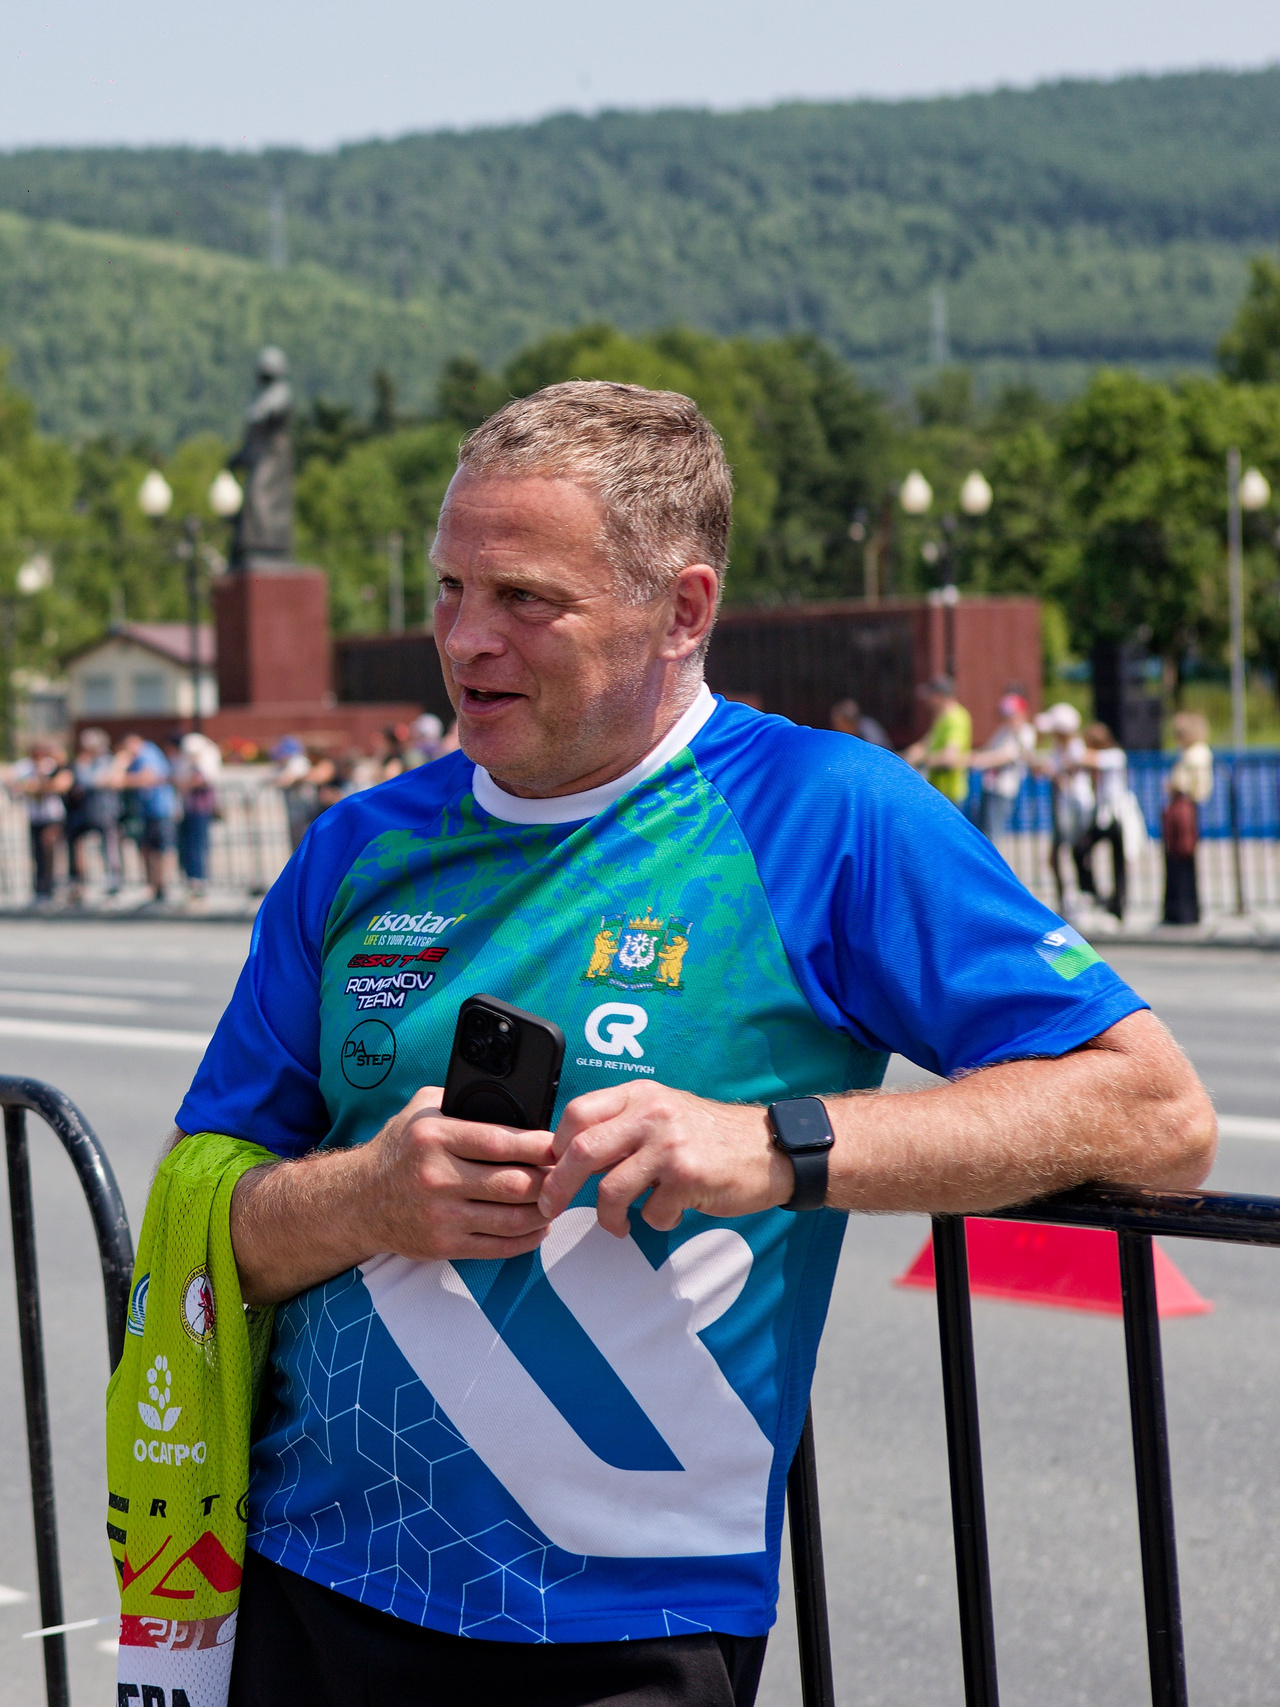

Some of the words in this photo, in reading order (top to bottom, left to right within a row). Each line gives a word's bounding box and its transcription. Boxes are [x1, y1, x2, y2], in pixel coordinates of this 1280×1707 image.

[371, 911, 457, 934] isostar
[363, 934, 380, 946] LIFE
[377, 934, 387, 946] IS
[386, 934, 405, 946] YOUR
[346, 973, 434, 994] ROMANOV
[357, 991, 406, 1010] TEAM
[356, 1053, 392, 1067] STEP
[576, 1057, 603, 1068] GLEB
[604, 1060, 655, 1074] RETIVYKH
